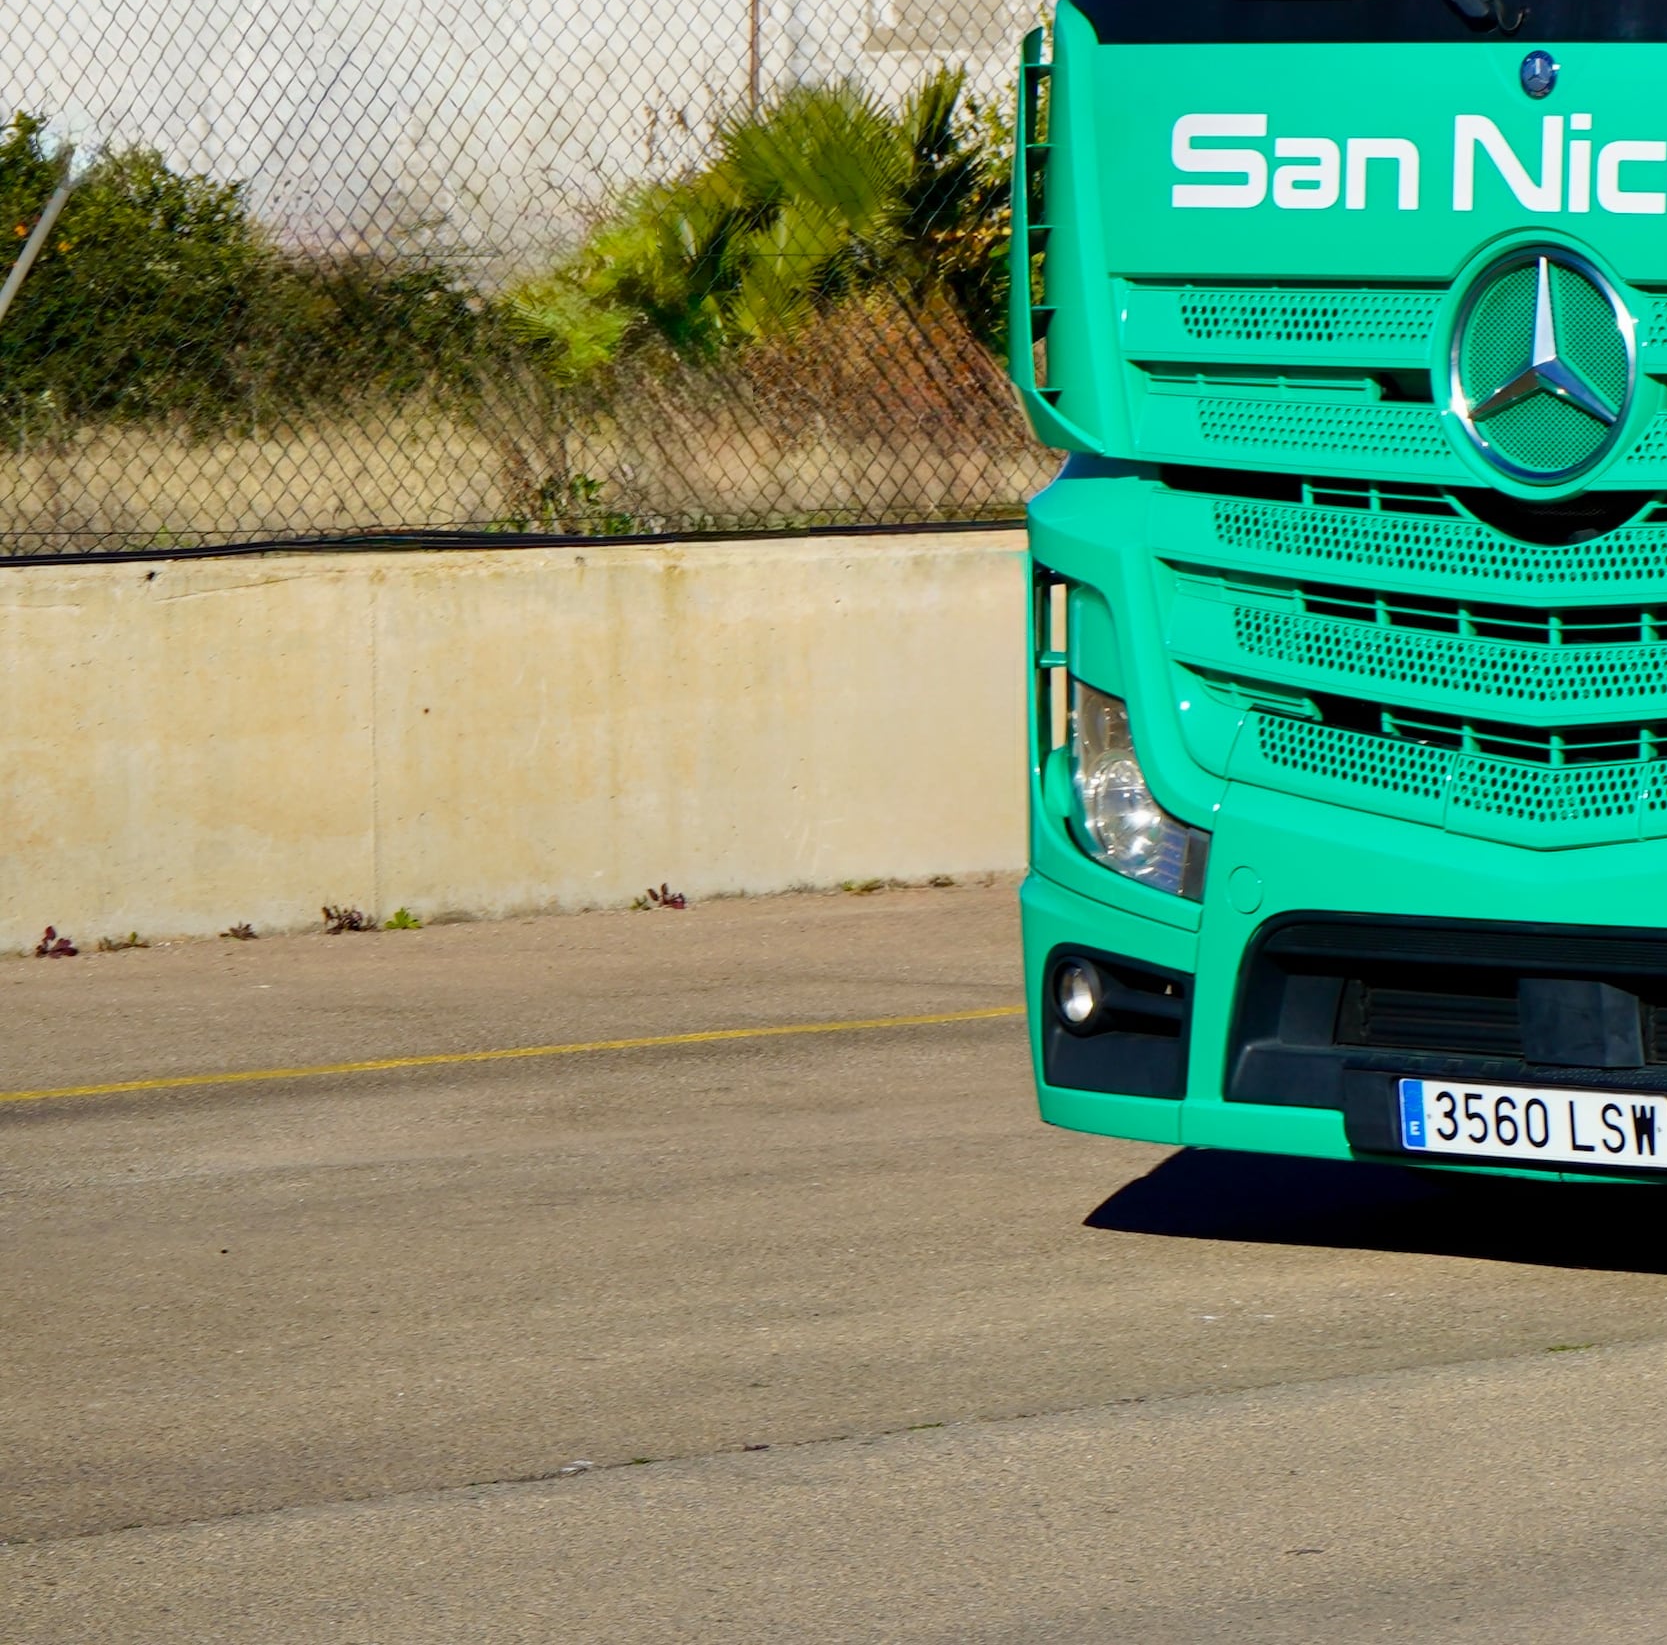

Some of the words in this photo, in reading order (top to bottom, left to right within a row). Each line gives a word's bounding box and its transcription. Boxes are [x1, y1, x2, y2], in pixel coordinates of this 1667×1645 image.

[1171, 113, 1420, 211] San
[1409, 1120, 1421, 1136] E
[1435, 1091, 1549, 1148] 3560
[1568, 1100, 1656, 1156] LSW
